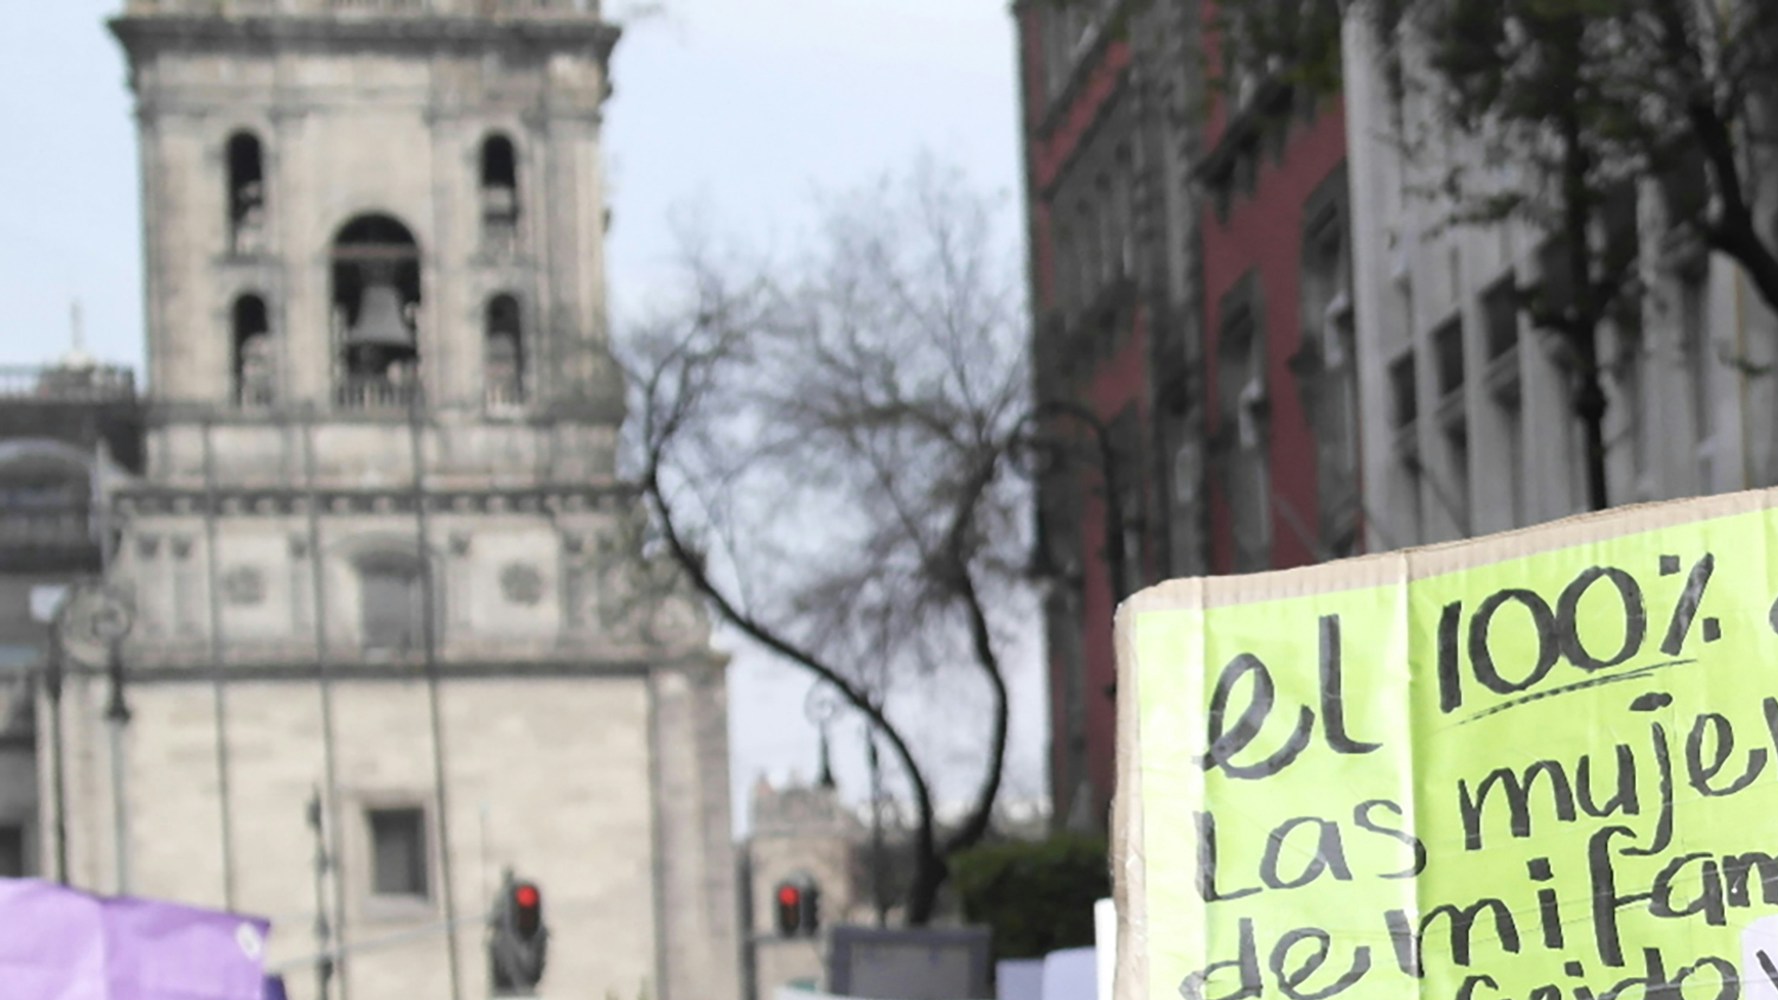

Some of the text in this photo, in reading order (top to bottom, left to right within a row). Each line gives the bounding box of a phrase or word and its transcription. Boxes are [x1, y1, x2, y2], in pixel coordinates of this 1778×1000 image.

[1193, 613, 1383, 780] el
[1437, 552, 1722, 714] 100%
[1384, 857, 1564, 979] mi
